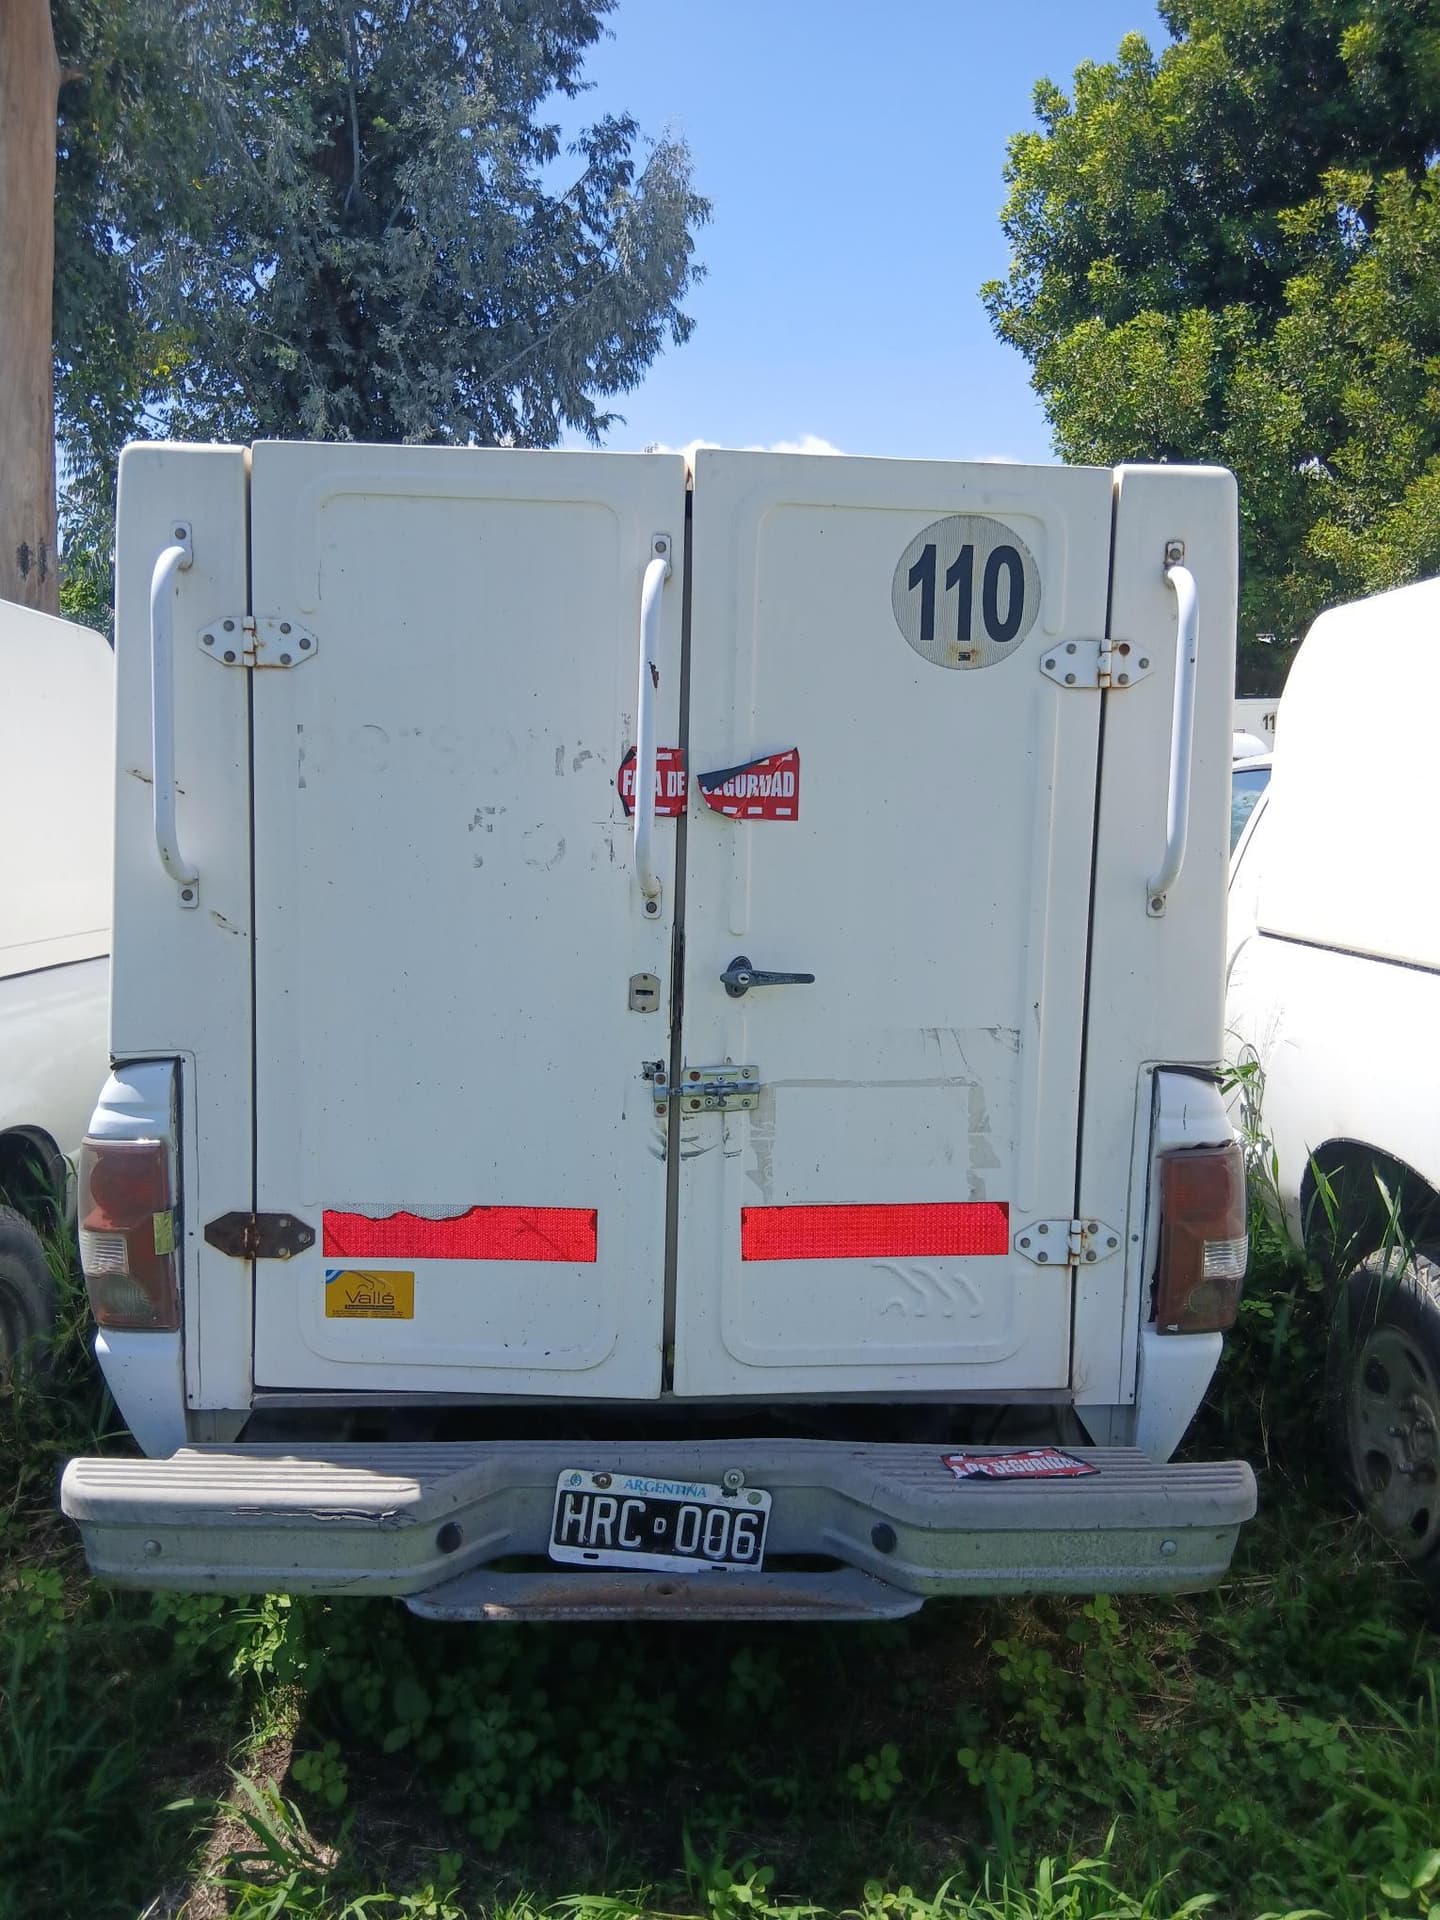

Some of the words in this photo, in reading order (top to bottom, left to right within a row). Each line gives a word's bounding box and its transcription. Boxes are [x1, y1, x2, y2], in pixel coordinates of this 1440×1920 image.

[908, 544, 1025, 643] 110
[1263, 714, 1275, 731] 11
[667, 771, 686, 797] DE
[345, 1290, 395, 1304] Vallé
[623, 1478, 708, 1498] ARGENTINA
[560, 1493, 647, 1548] HRC
[654, 1517, 667, 1534] D
[675, 1505, 760, 1561] 006
